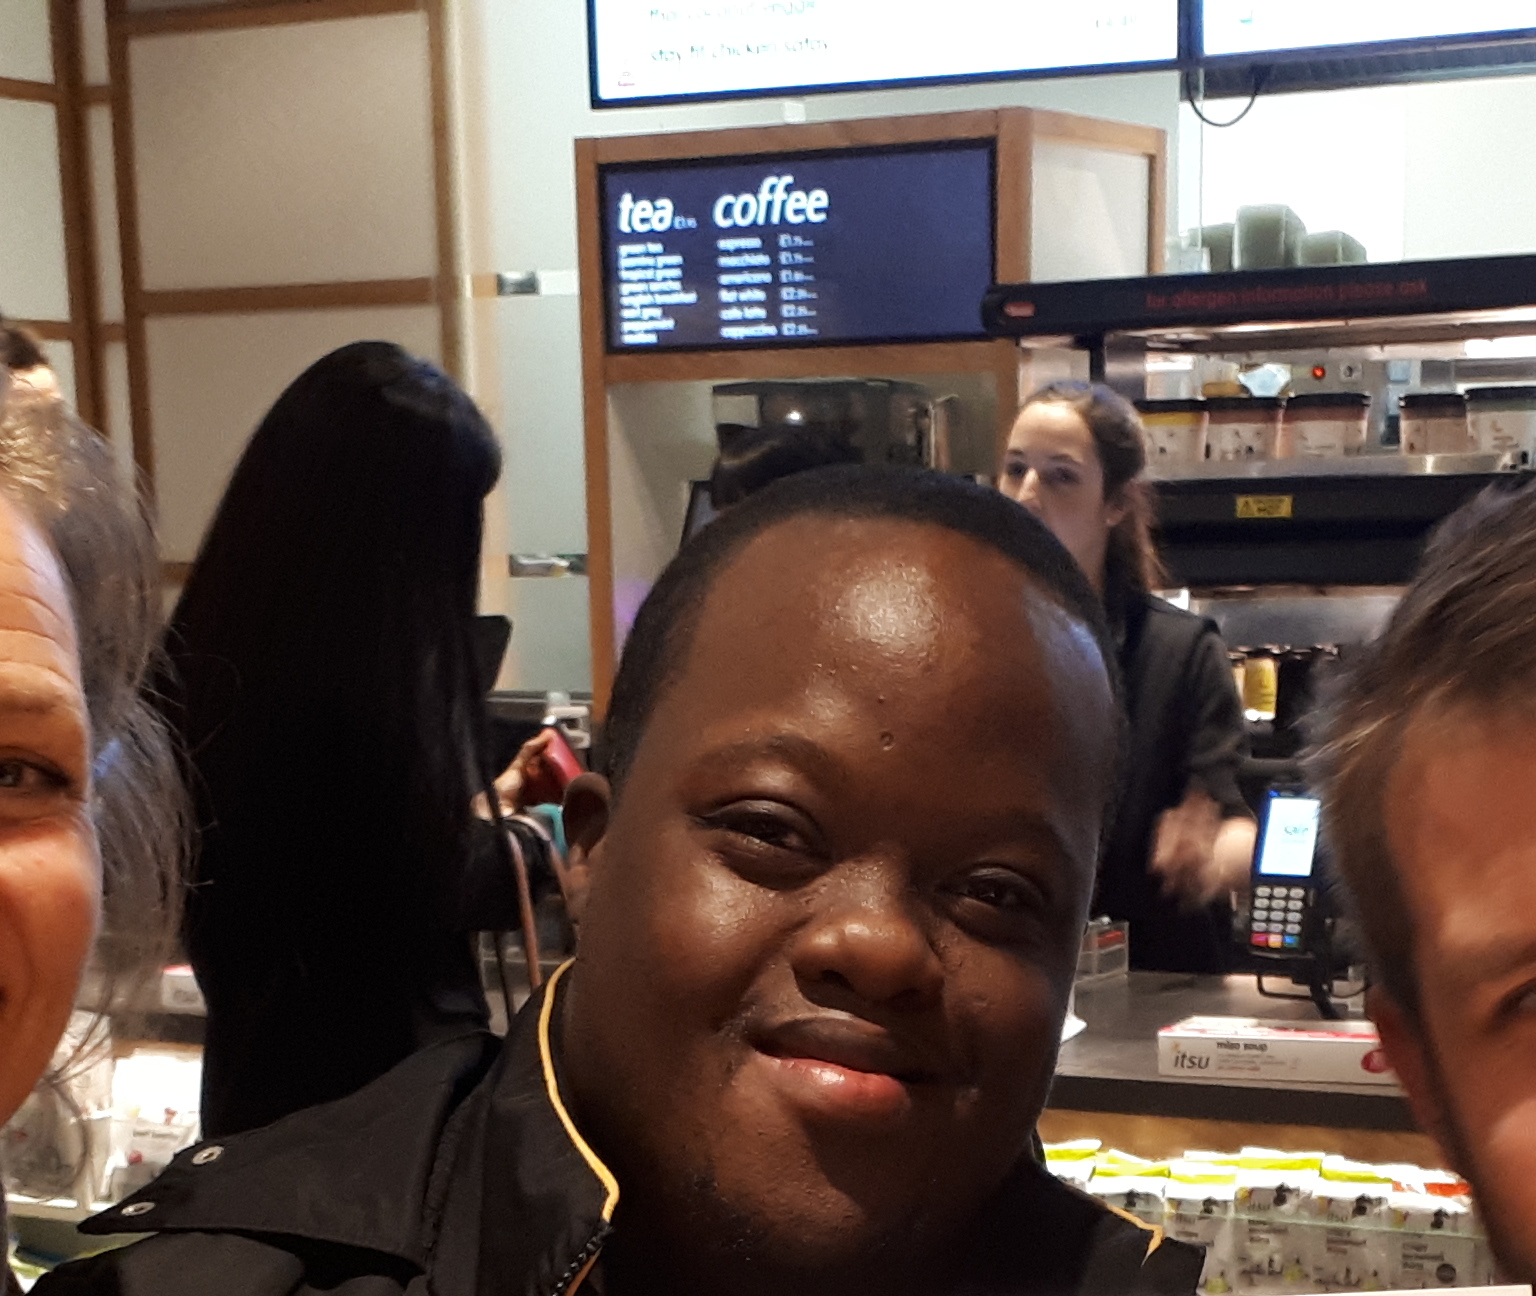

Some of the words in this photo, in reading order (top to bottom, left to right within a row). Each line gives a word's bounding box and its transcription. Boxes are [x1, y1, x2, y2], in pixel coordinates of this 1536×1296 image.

[618, 191, 674, 233] tea
[714, 175, 829, 227] coffee
[1173, 1051, 1211, 1070] itsu
